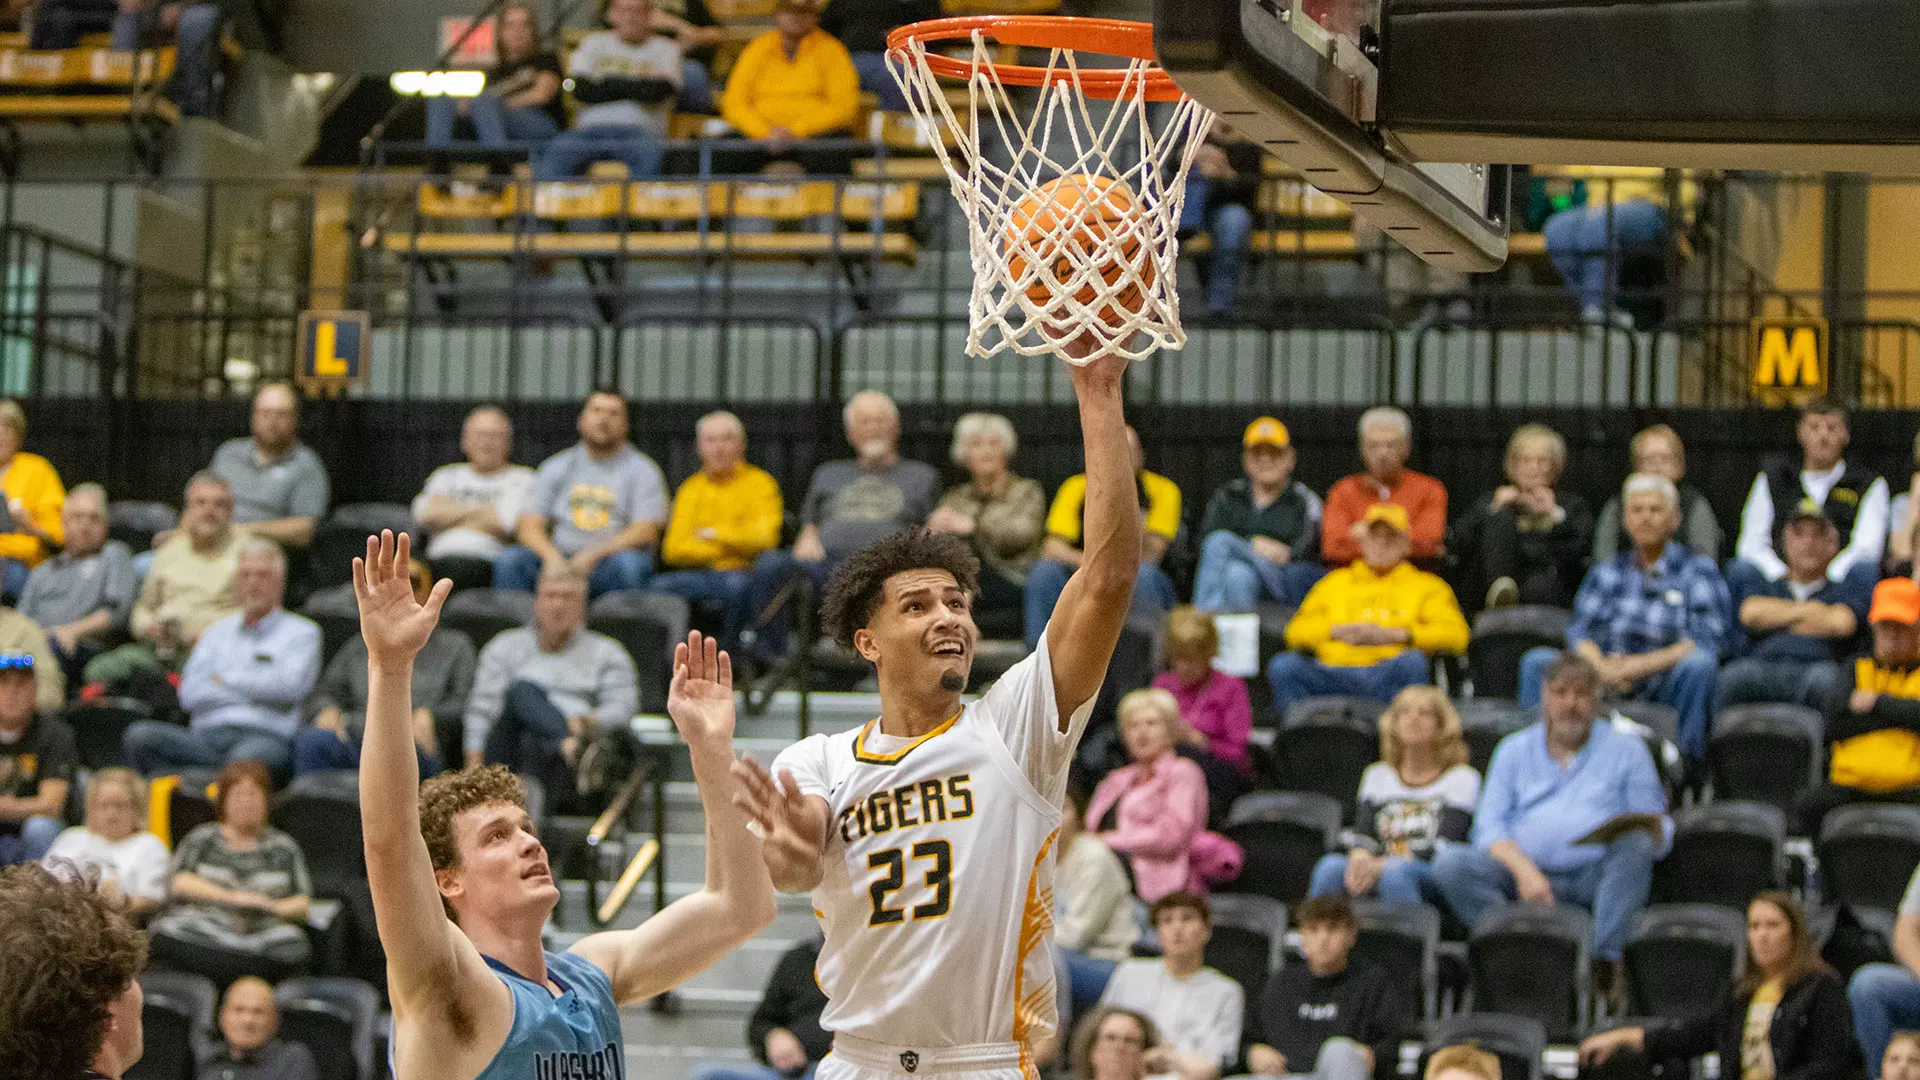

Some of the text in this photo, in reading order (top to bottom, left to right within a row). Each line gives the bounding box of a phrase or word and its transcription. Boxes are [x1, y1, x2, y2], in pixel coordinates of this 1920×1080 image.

[315, 322, 348, 376] L
[1757, 327, 1820, 385] M
[839, 773, 974, 843] TIGERS
[867, 838, 953, 929] 23
